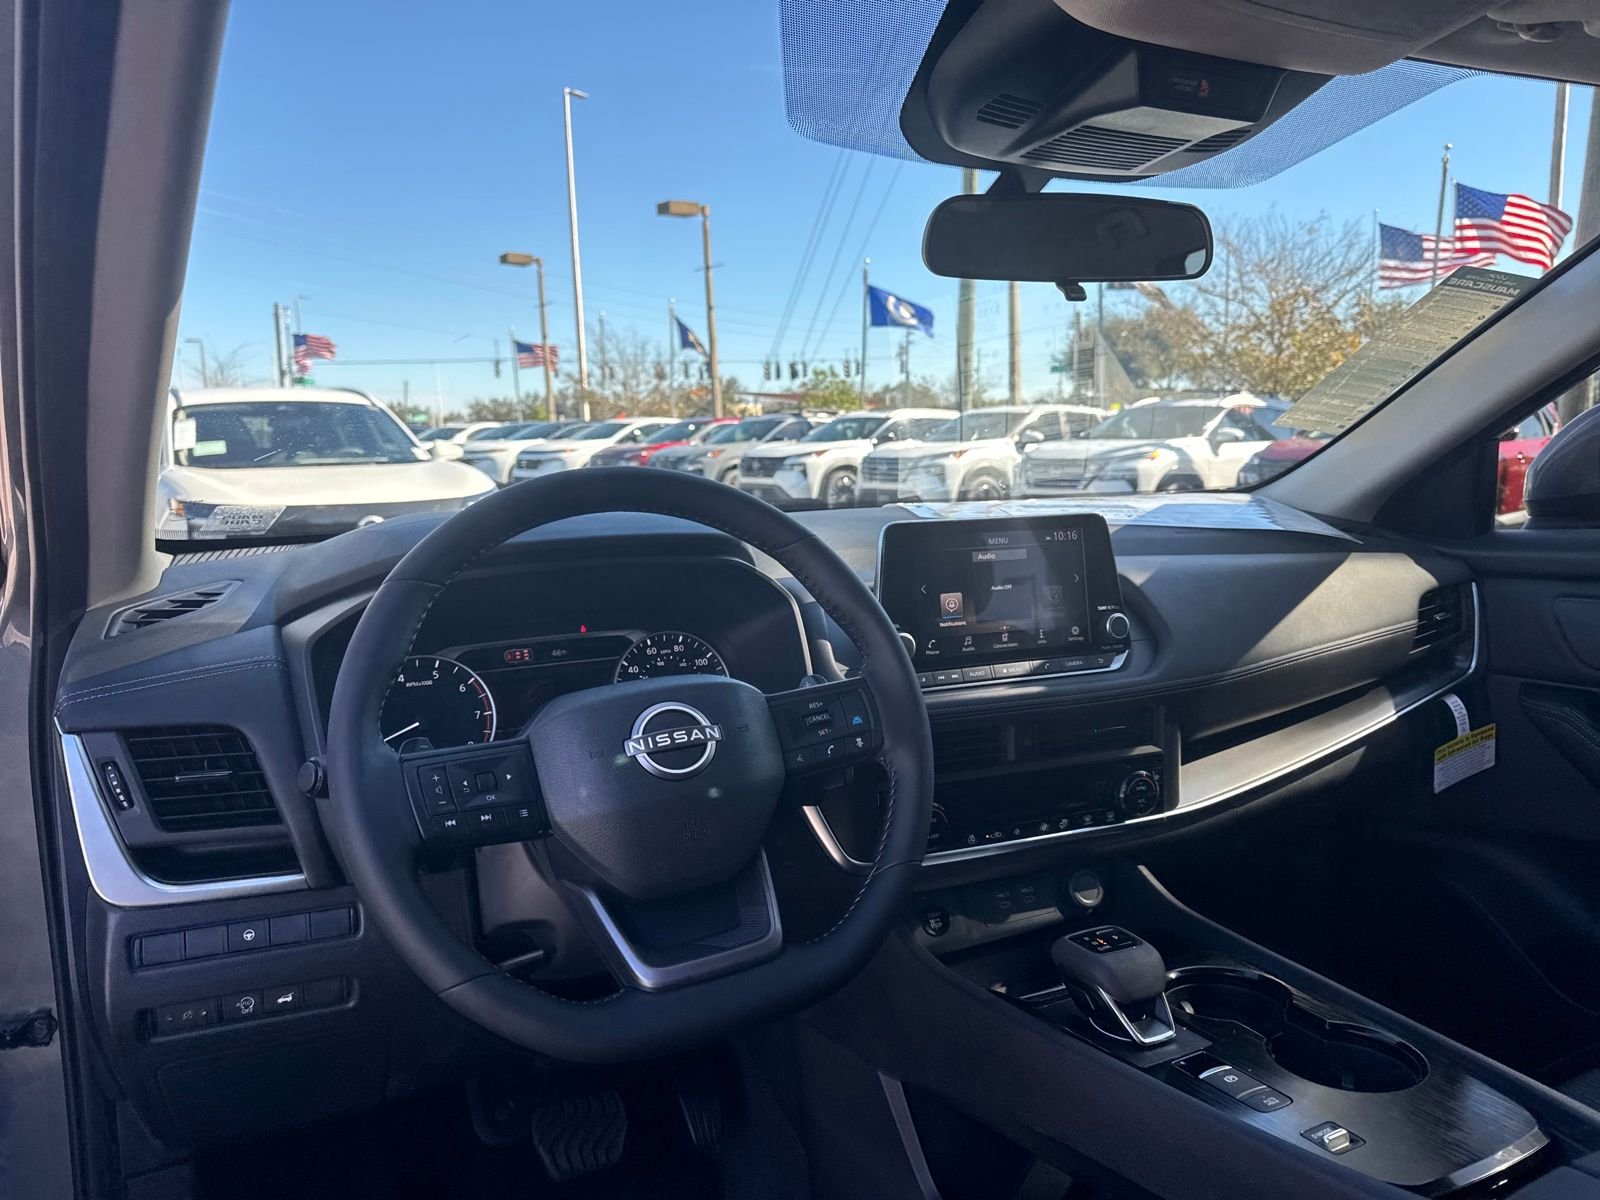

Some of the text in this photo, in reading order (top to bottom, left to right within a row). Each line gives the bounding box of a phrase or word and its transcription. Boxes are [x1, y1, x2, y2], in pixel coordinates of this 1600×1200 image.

[1053, 530, 1078, 541] 10:16
[988, 537, 1008, 545] MENU
[646, 647, 657, 655] 60
[673, 644, 684, 652] 80
[695, 657, 708, 666] 100
[628, 665, 639, 673] 40
[397, 674, 405, 682] 4
[432, 670, 440, 679] 5
[459, 683, 466, 692] 6
[474, 710, 481, 719] 7
[808, 713, 831, 723] CANCEL
[628, 727, 720, 753] NISSAN
